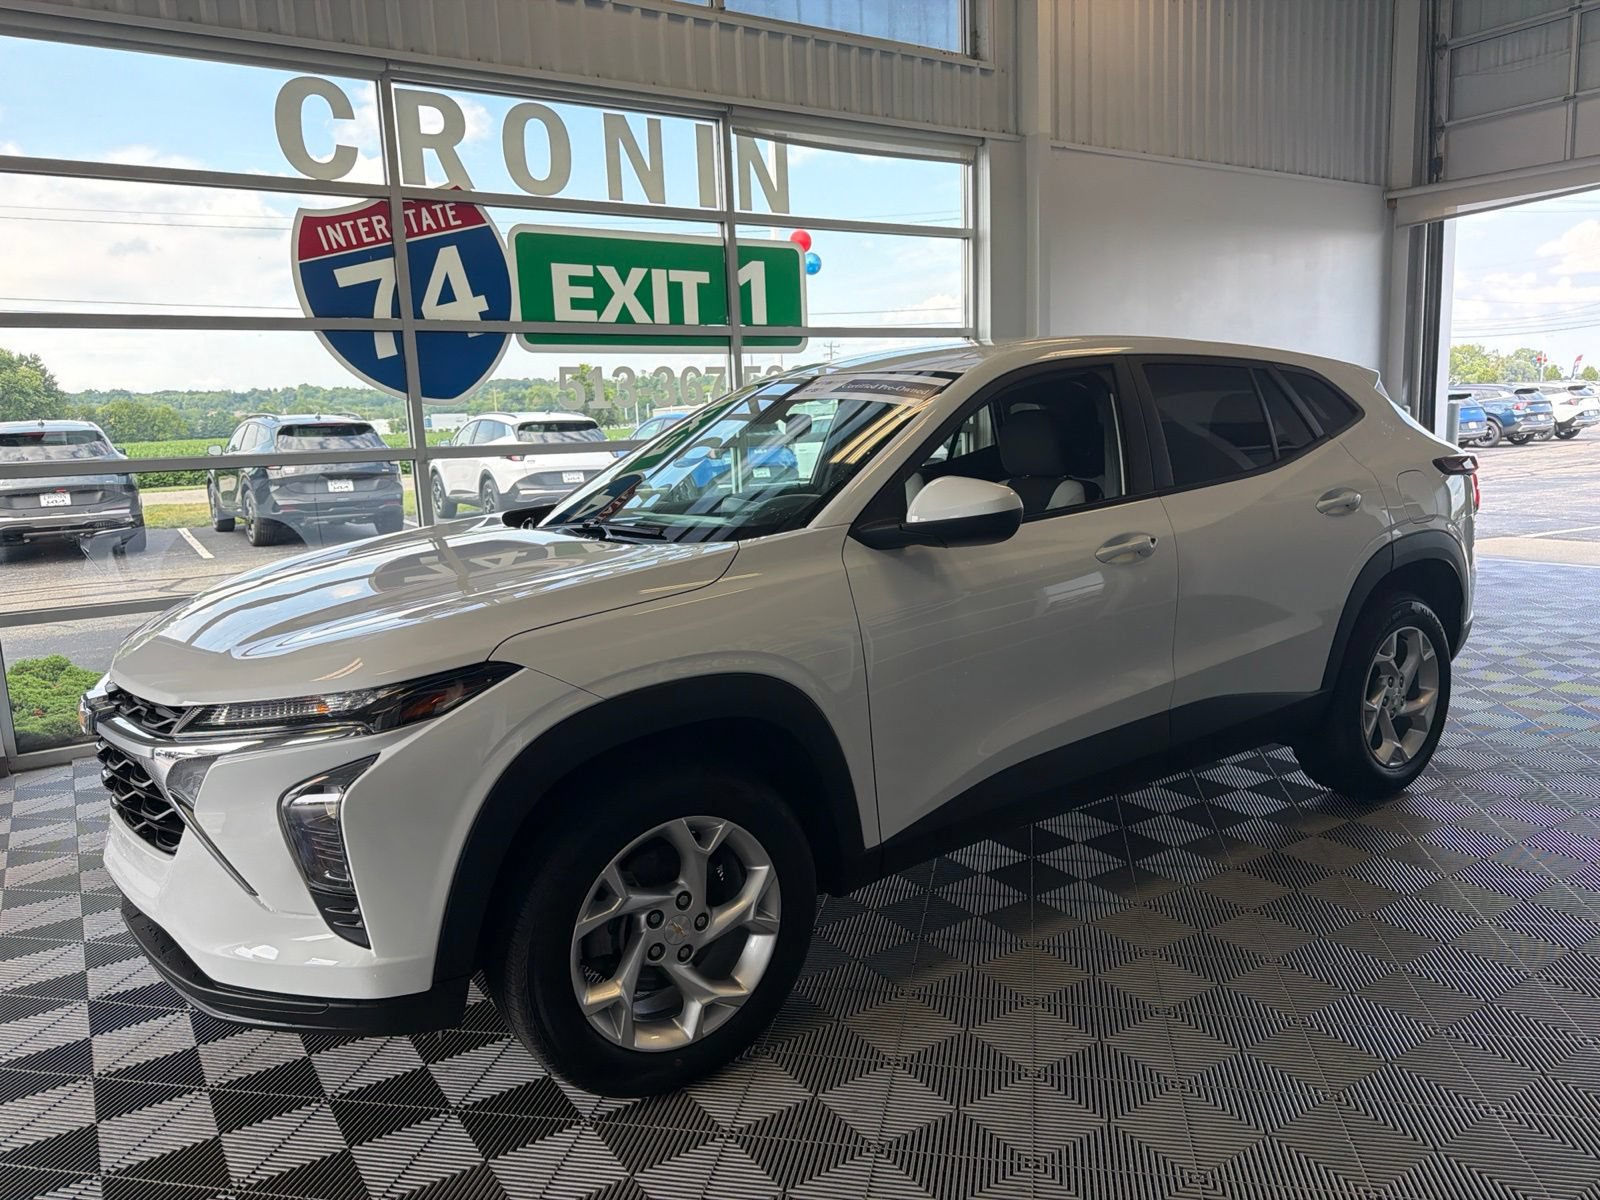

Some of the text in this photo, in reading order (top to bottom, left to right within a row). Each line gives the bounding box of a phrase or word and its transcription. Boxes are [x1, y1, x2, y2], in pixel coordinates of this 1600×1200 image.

[275, 76, 790, 214] CRONIN
[317, 203, 462, 252] INTERTATE
[333, 245, 490, 360] 74
[551, 260, 768, 326] EXIT 1
[878, 384, 930, 395] Pre-Owned
